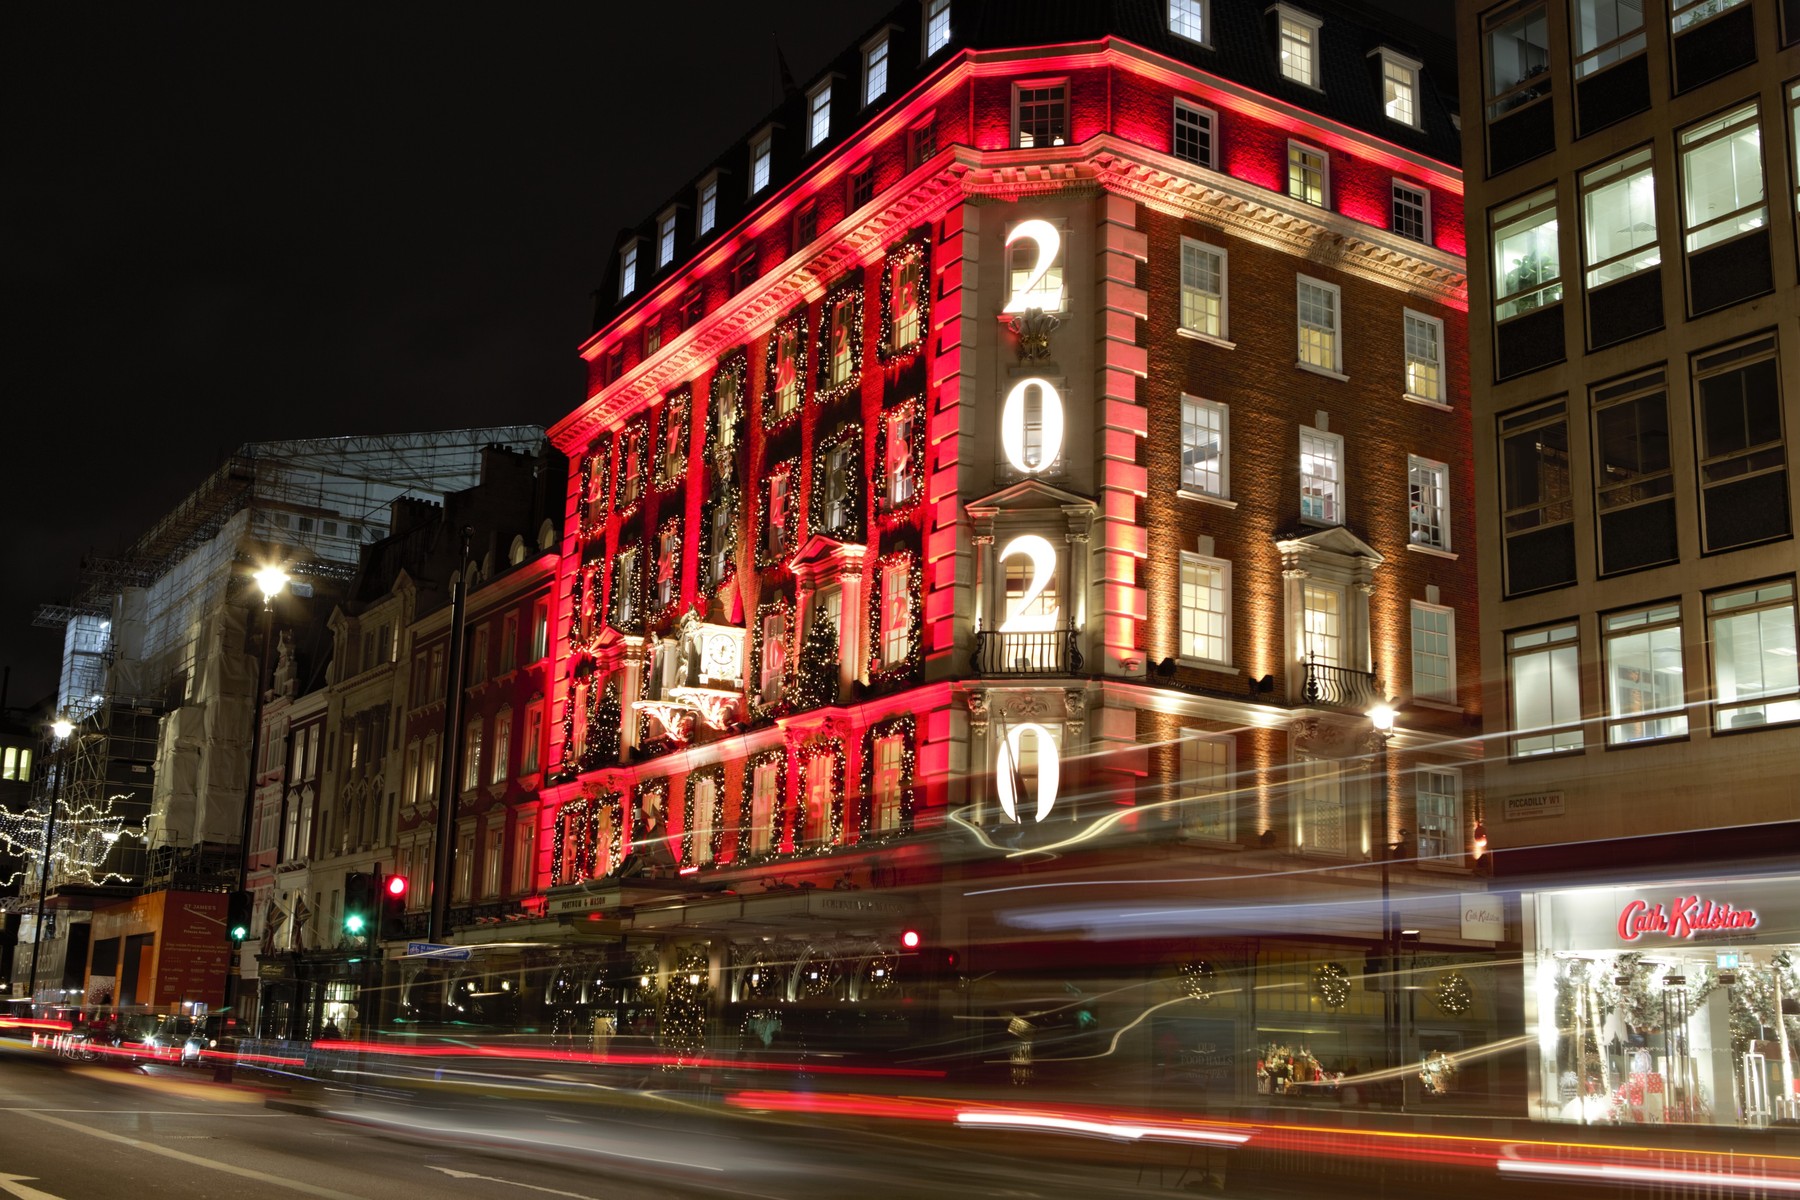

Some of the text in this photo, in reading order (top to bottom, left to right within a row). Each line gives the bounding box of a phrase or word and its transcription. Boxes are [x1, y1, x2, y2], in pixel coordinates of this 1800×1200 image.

[1508, 794, 1560, 809] PICCADILLY W1
[561, 896, 606, 910] FORTNUM & MASON
[1618, 895, 1757, 941] Cath Kidston
[1181, 1055, 1234, 1066] FOOD HALLS
